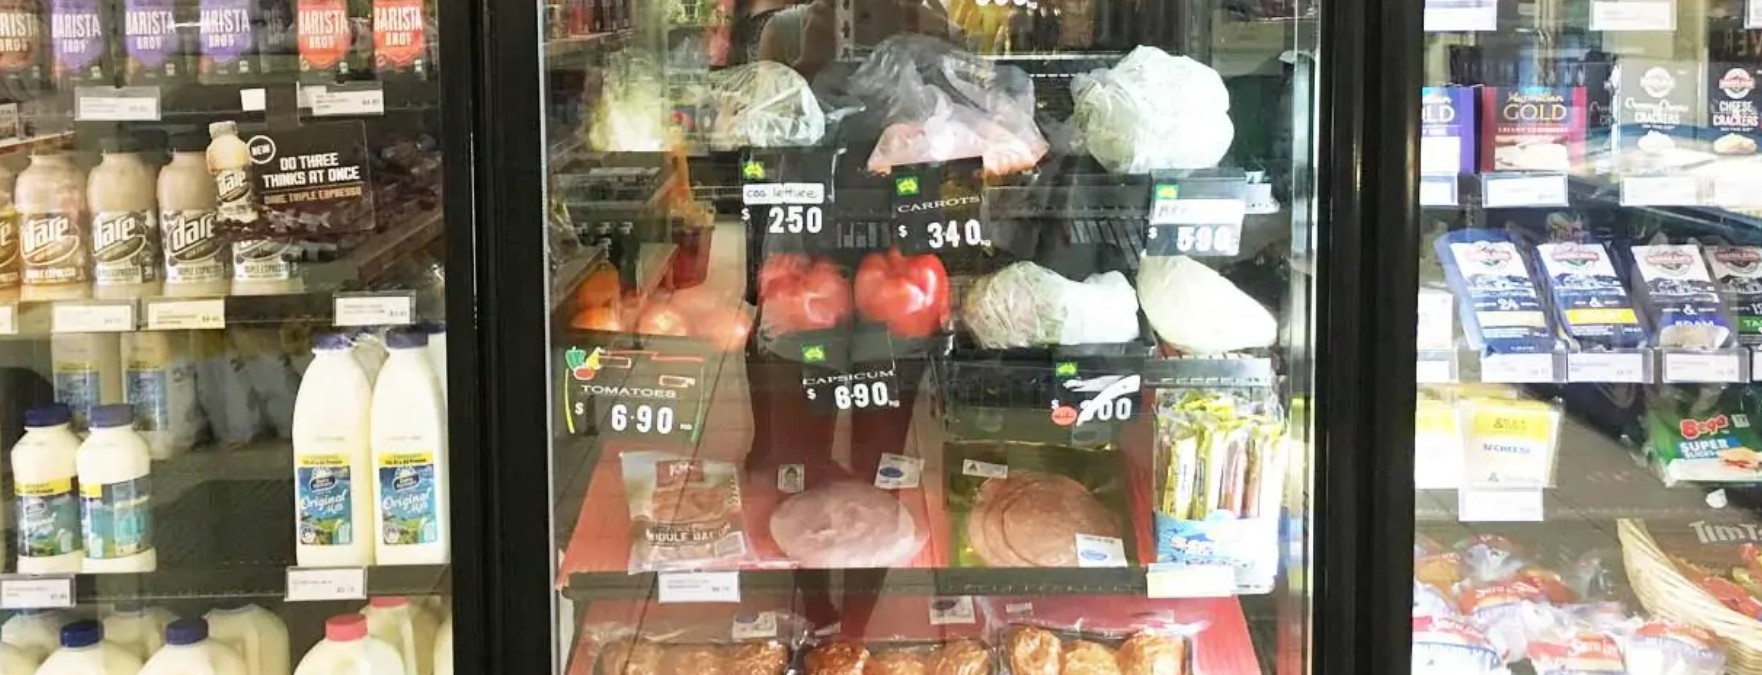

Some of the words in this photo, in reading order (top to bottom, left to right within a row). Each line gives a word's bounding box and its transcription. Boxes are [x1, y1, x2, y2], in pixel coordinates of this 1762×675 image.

[52, 12, 102, 39] BARISTA
[126, 9, 175, 35] BARISTA
[299, 9, 350, 35] BARISTA
[374, 5, 423, 31] BARISTA
[1503, 103, 1567, 121] GOLD
[1719, 101, 1753, 112] CHEESE
[1712, 114, 1759, 127] CRACKERS
[250, 144, 270, 157] NEW
[280, 156, 297, 171] DO
[298, 152, 340, 170] THREE
[262, 171, 306, 188] THINKS
[309, 169, 325, 185] AT
[327, 165, 361, 182] ONCE
[288, 191, 318, 203] TRIPLE
[318, 186, 362, 201] ESPRESSO
[772, 186, 820, 199] lettuce
[897, 195, 982, 213] CARROTS
[741, 207, 751, 221] $
[898, 225, 908, 238] $
[1148, 226, 1158, 240] $
[1682, 303, 1698, 315] &
[802, 369, 895, 386] CAPSICUM
[580, 384, 677, 399] TOMATOES
[806, 388, 817, 401] $
[574, 402, 585, 416] $
[1680, 414, 1729, 440] Bega
[1679, 439, 1730, 453] SUPER
[301, 488, 347, 511] Original
[383, 488, 431, 511] Original
[1688, 519, 1762, 543] TimT
